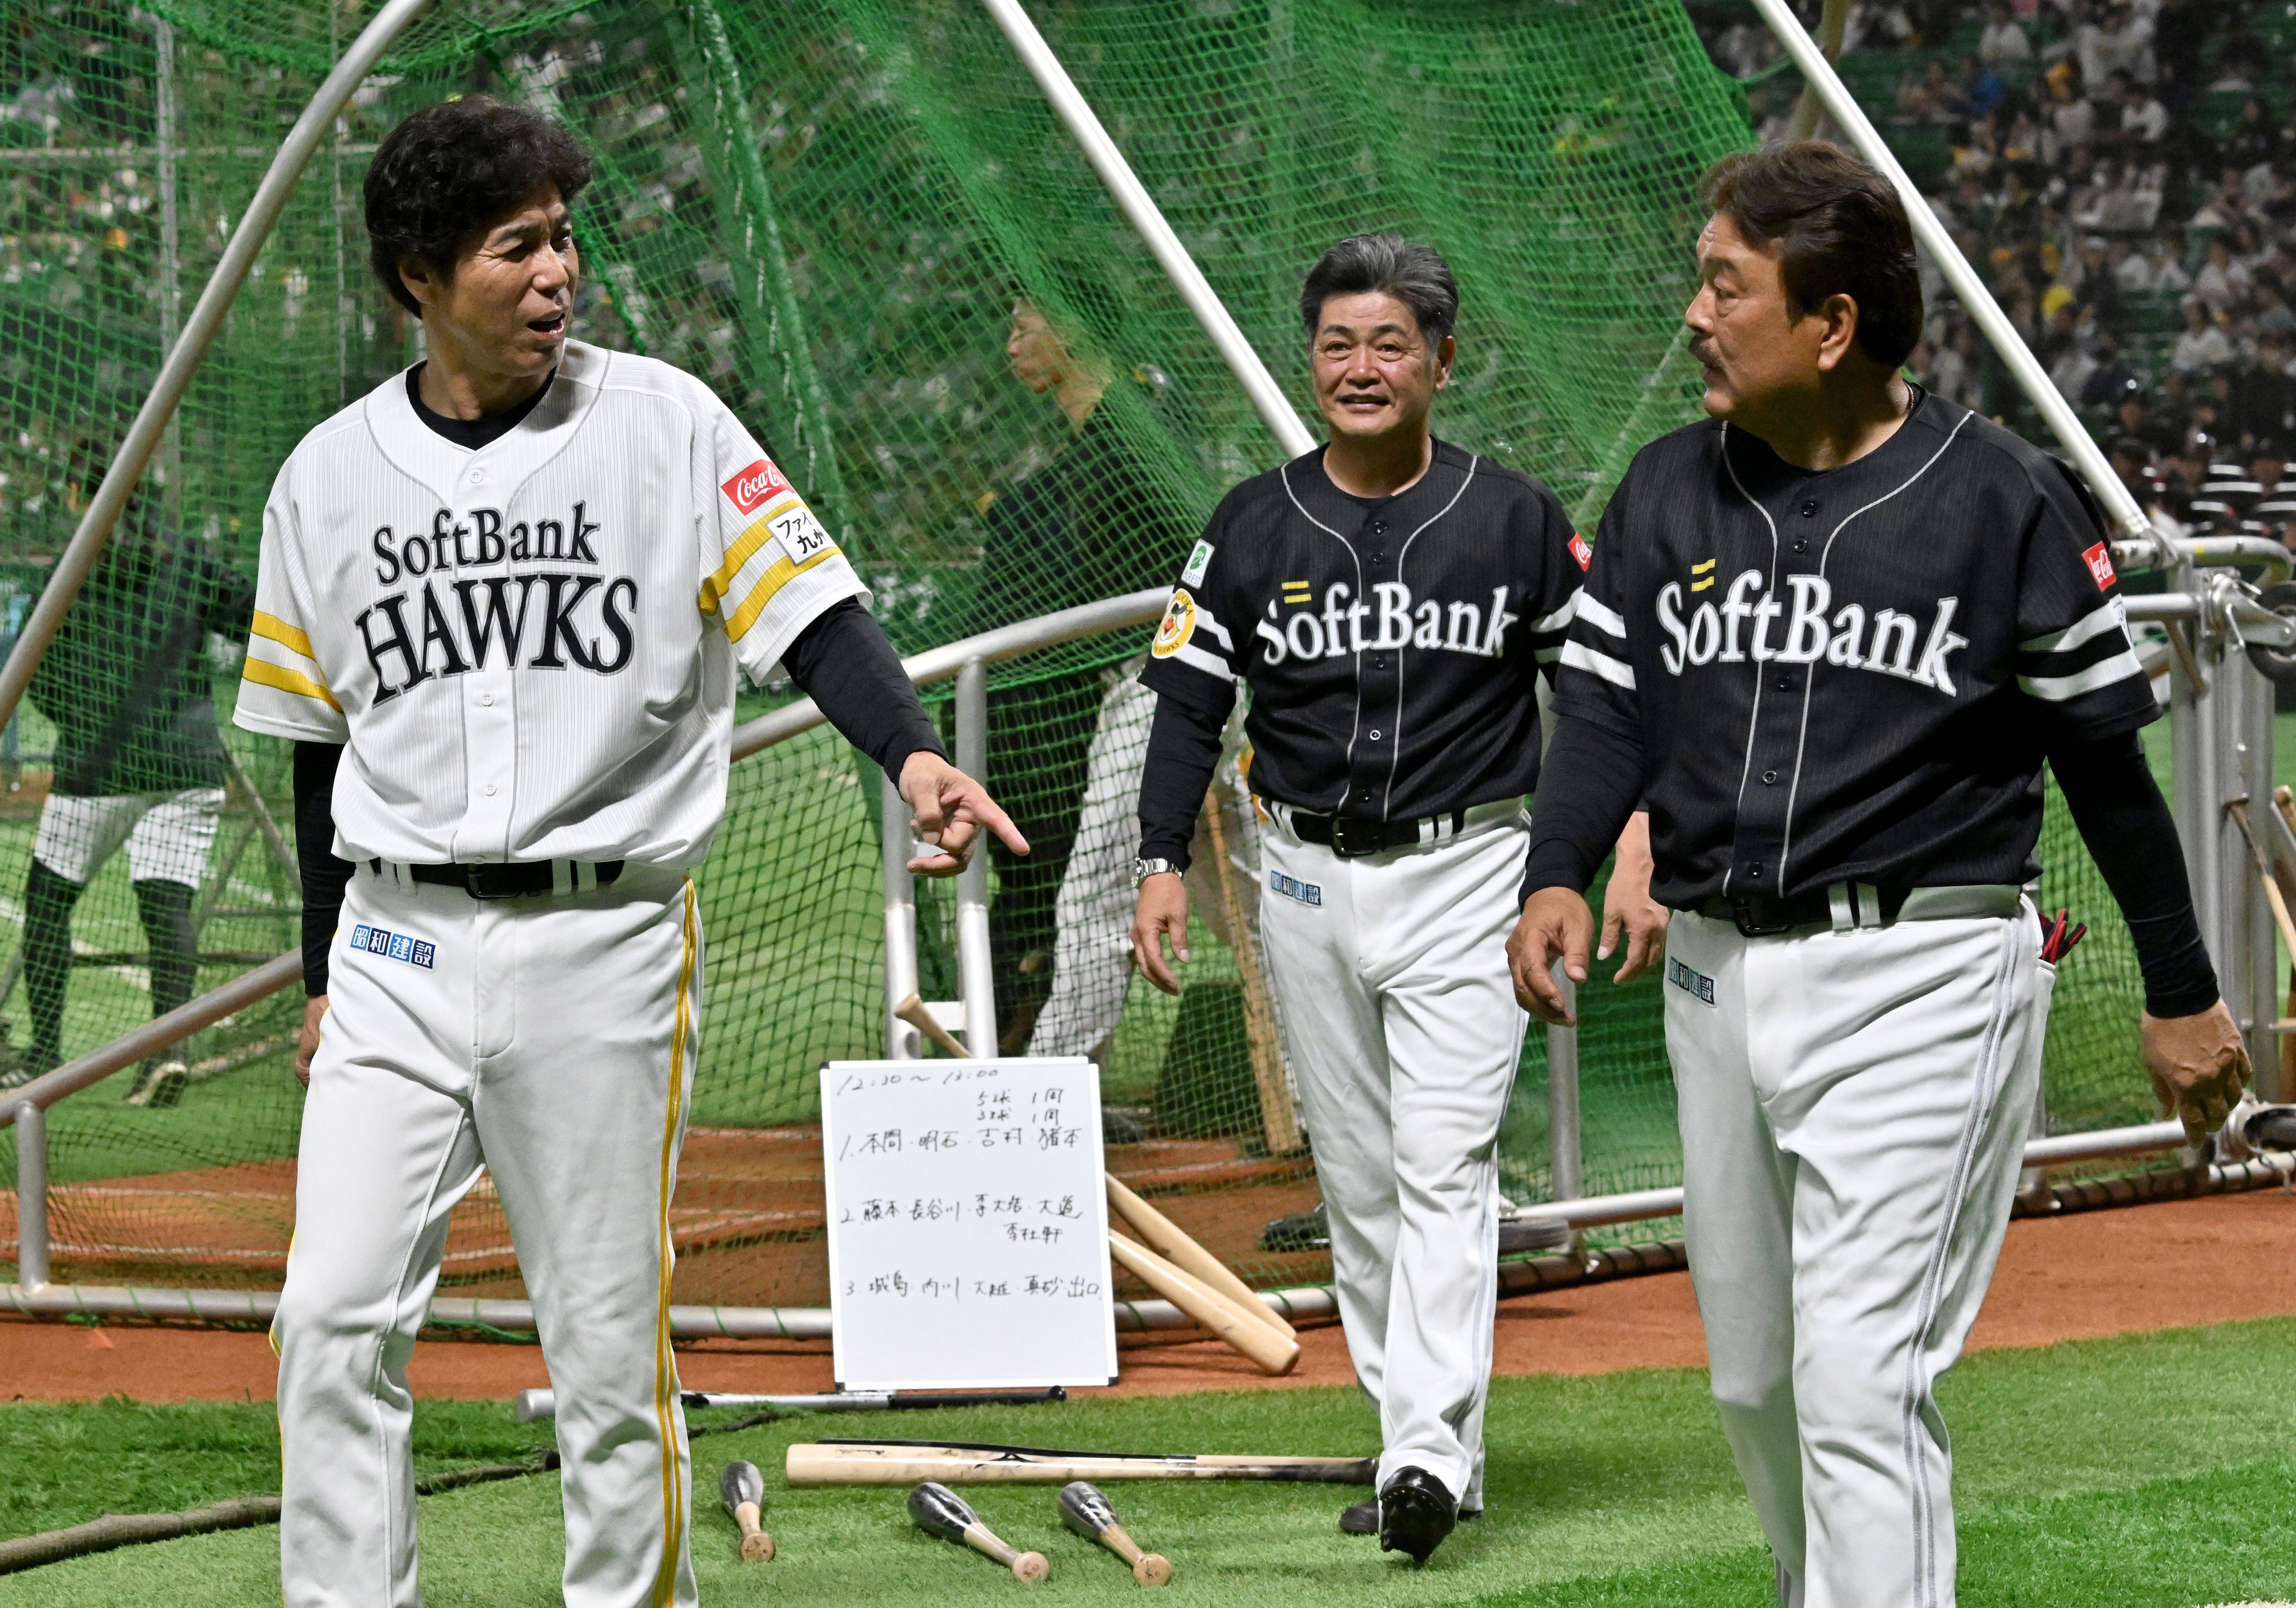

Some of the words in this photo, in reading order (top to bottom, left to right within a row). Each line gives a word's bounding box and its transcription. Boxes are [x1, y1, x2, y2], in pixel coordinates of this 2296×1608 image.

[374, 500, 600, 586] SoftBank
[776, 512, 813, 539] ファイ
[355, 571, 639, 709] HAWKS
[1256, 581, 1518, 666] SoftBank
[1656, 569, 1969, 696] SoftBank
[352, 927, 432, 967] 昭和建設
